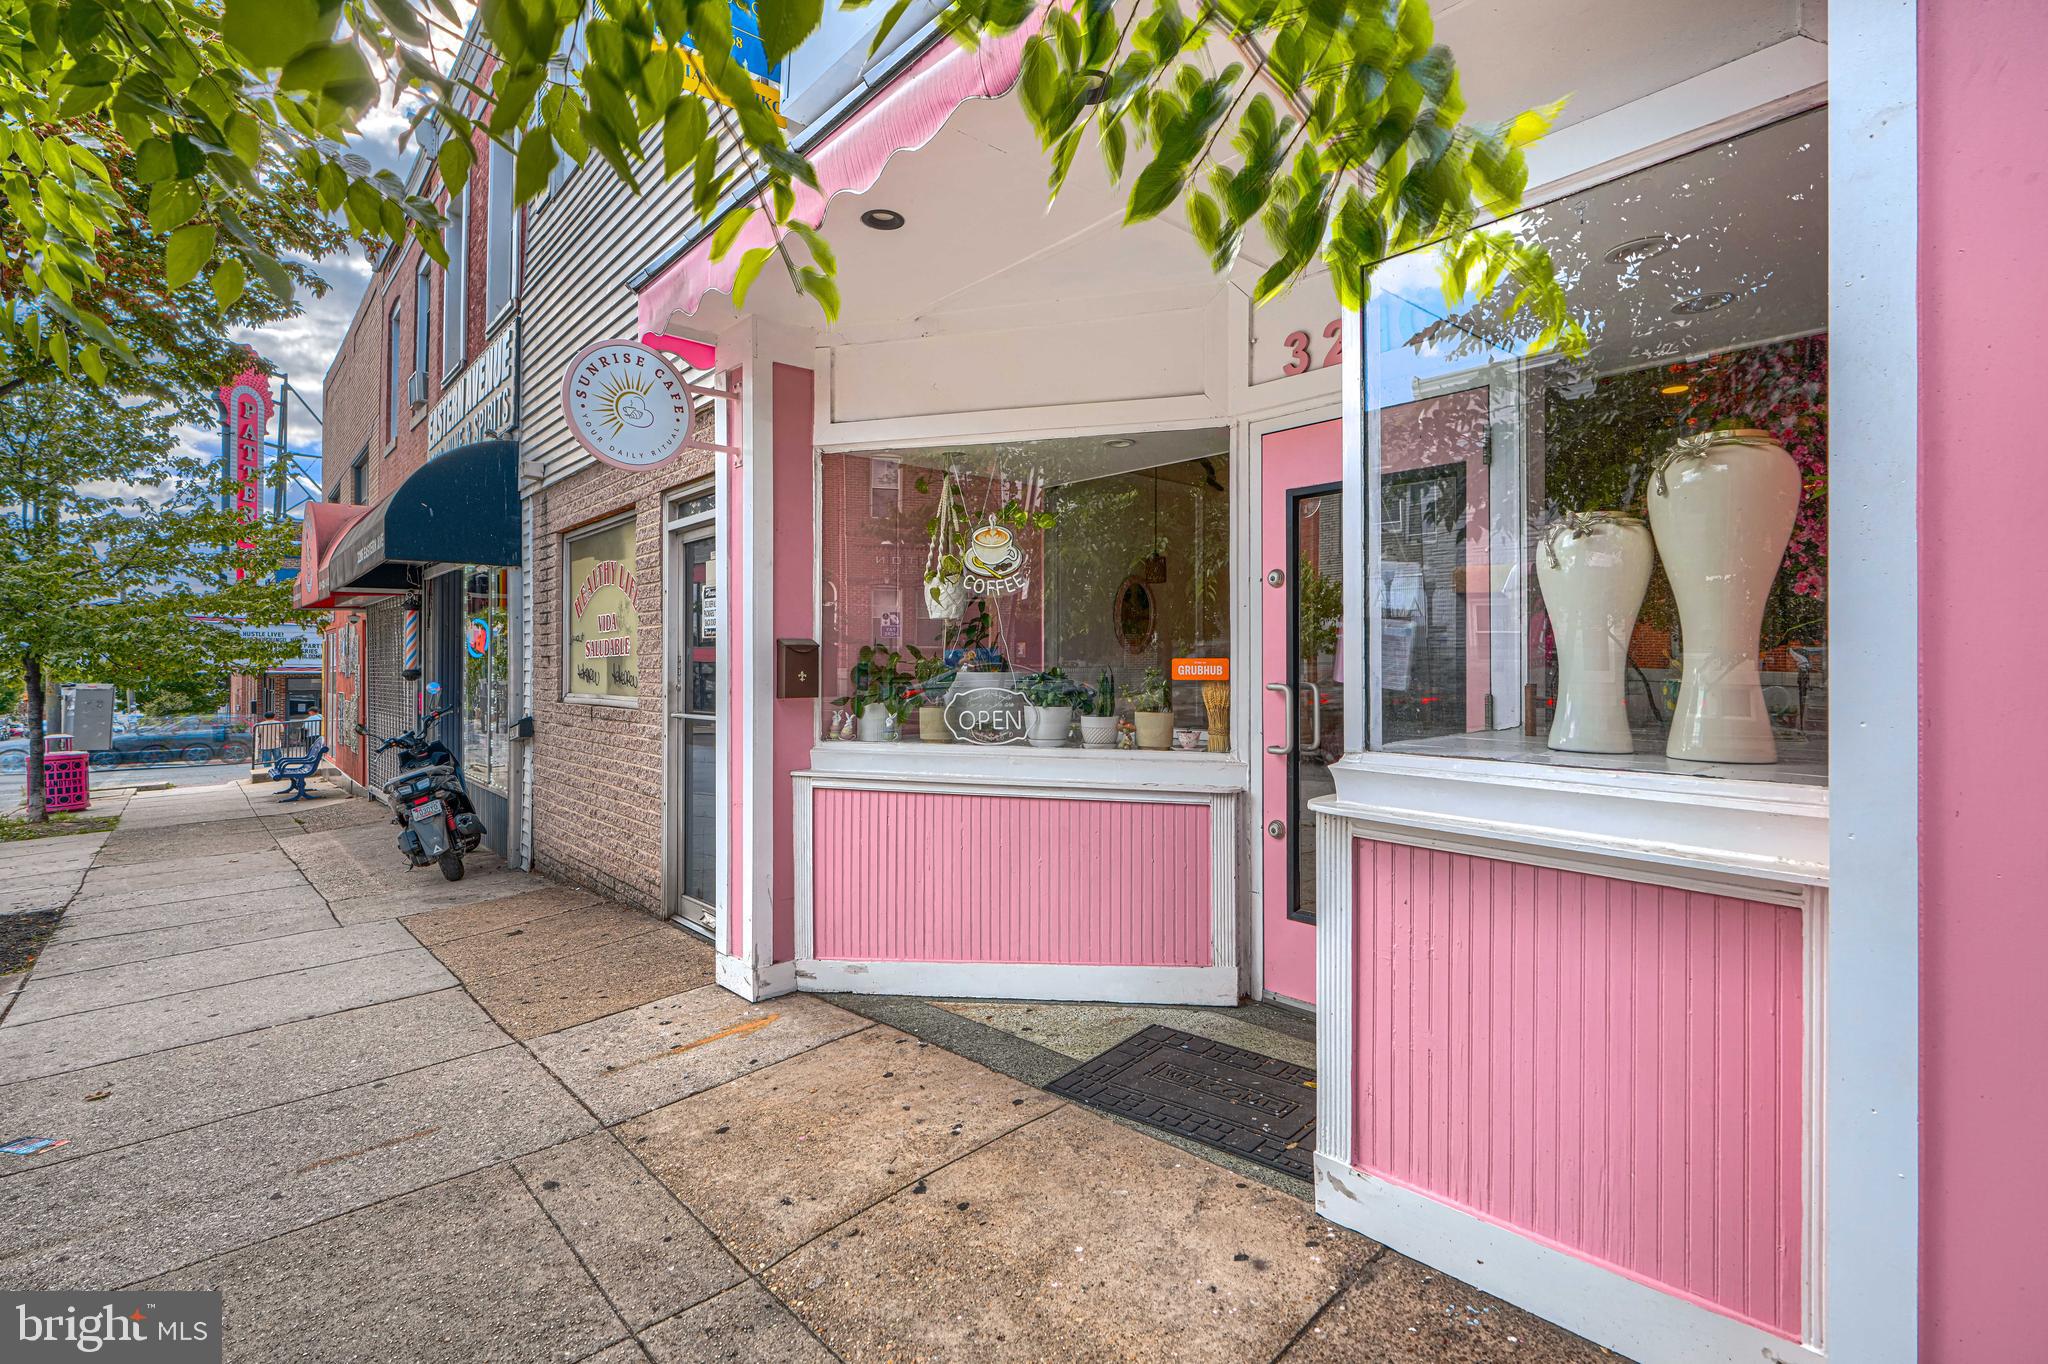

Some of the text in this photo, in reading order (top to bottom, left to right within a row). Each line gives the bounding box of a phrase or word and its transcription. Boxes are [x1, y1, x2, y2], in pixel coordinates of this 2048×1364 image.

[429, 330, 512, 451] EASTERN AVENUE
[576, 353, 684, 414] SUNRISE CAFE
[474, 388, 511, 442] SPIRITS
[582, 414, 680, 459] YOUR DAILY RITUAL
[574, 560, 618, 619] HEALTHY
[963, 572, 1026, 596] COFFEE
[597, 613, 618, 633] VIDA
[585, 637, 630, 658] SALUDABLE
[1177, 665, 1223, 675] GRUBHUB
[958, 710, 1022, 730] OPEN
